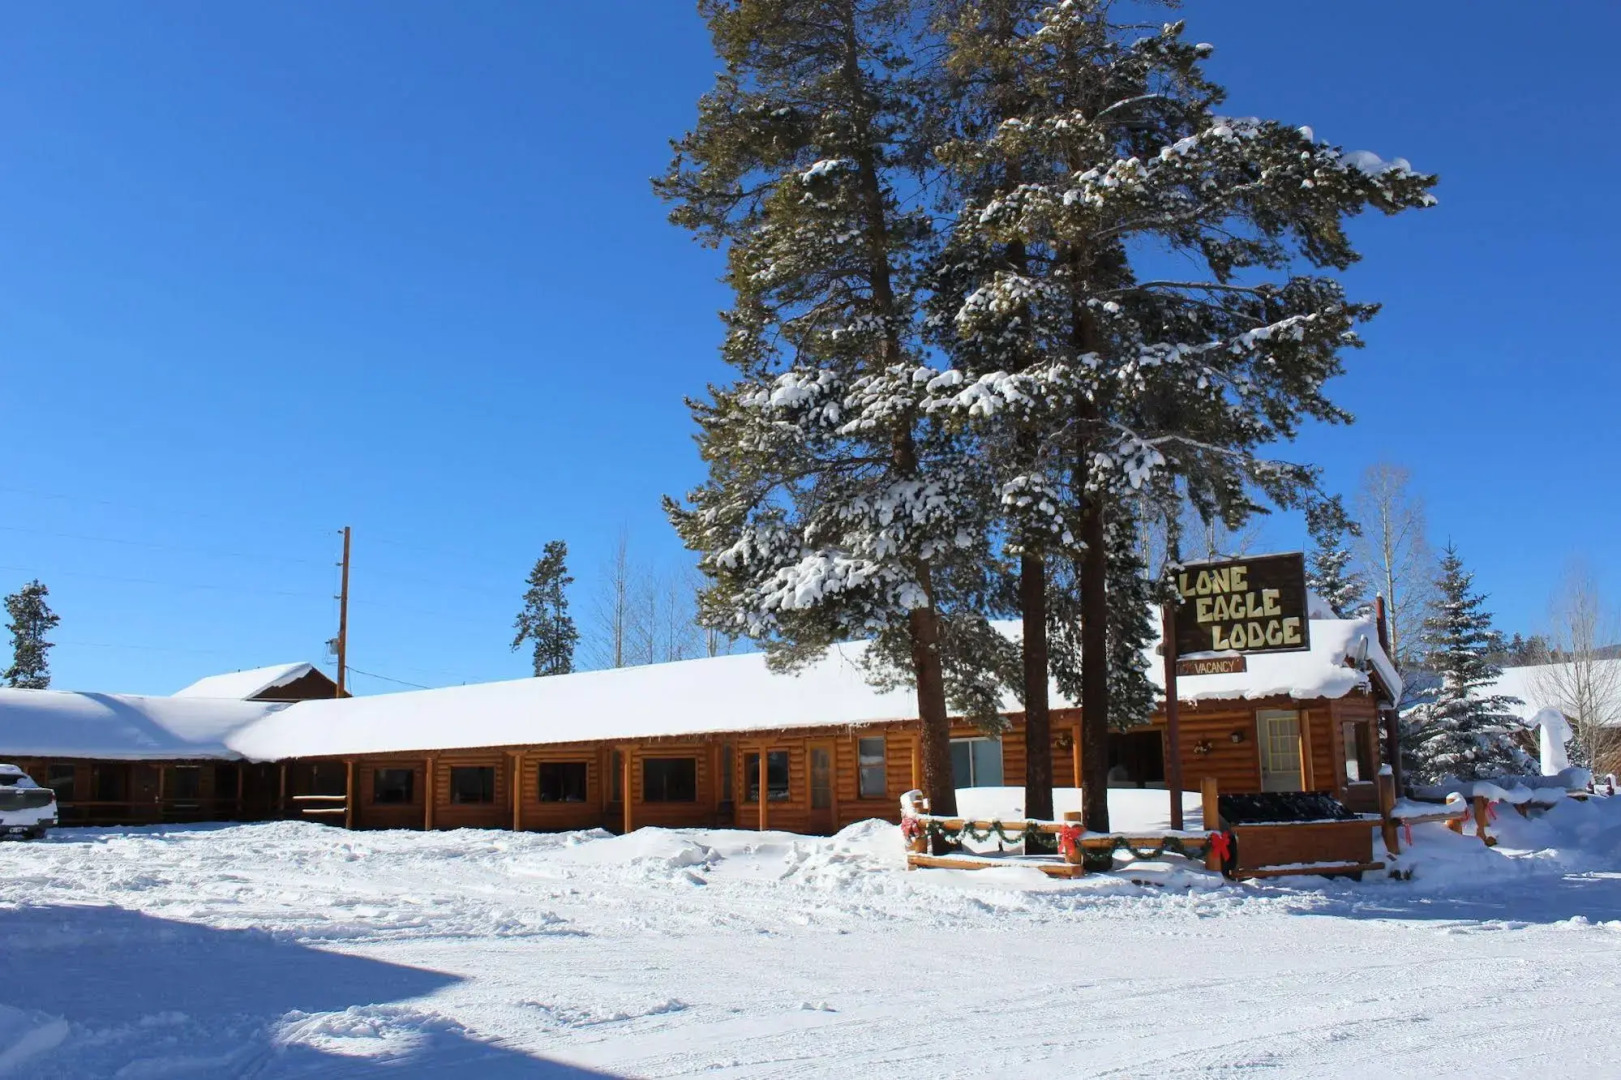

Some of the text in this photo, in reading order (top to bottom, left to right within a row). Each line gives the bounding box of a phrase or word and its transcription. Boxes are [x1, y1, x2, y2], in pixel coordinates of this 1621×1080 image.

[1179, 566, 1248, 597] LONE
[1196, 588, 1281, 623] EAGLE
[1212, 617, 1301, 650] LODGE
[1194, 661, 1235, 674] VACANCY
